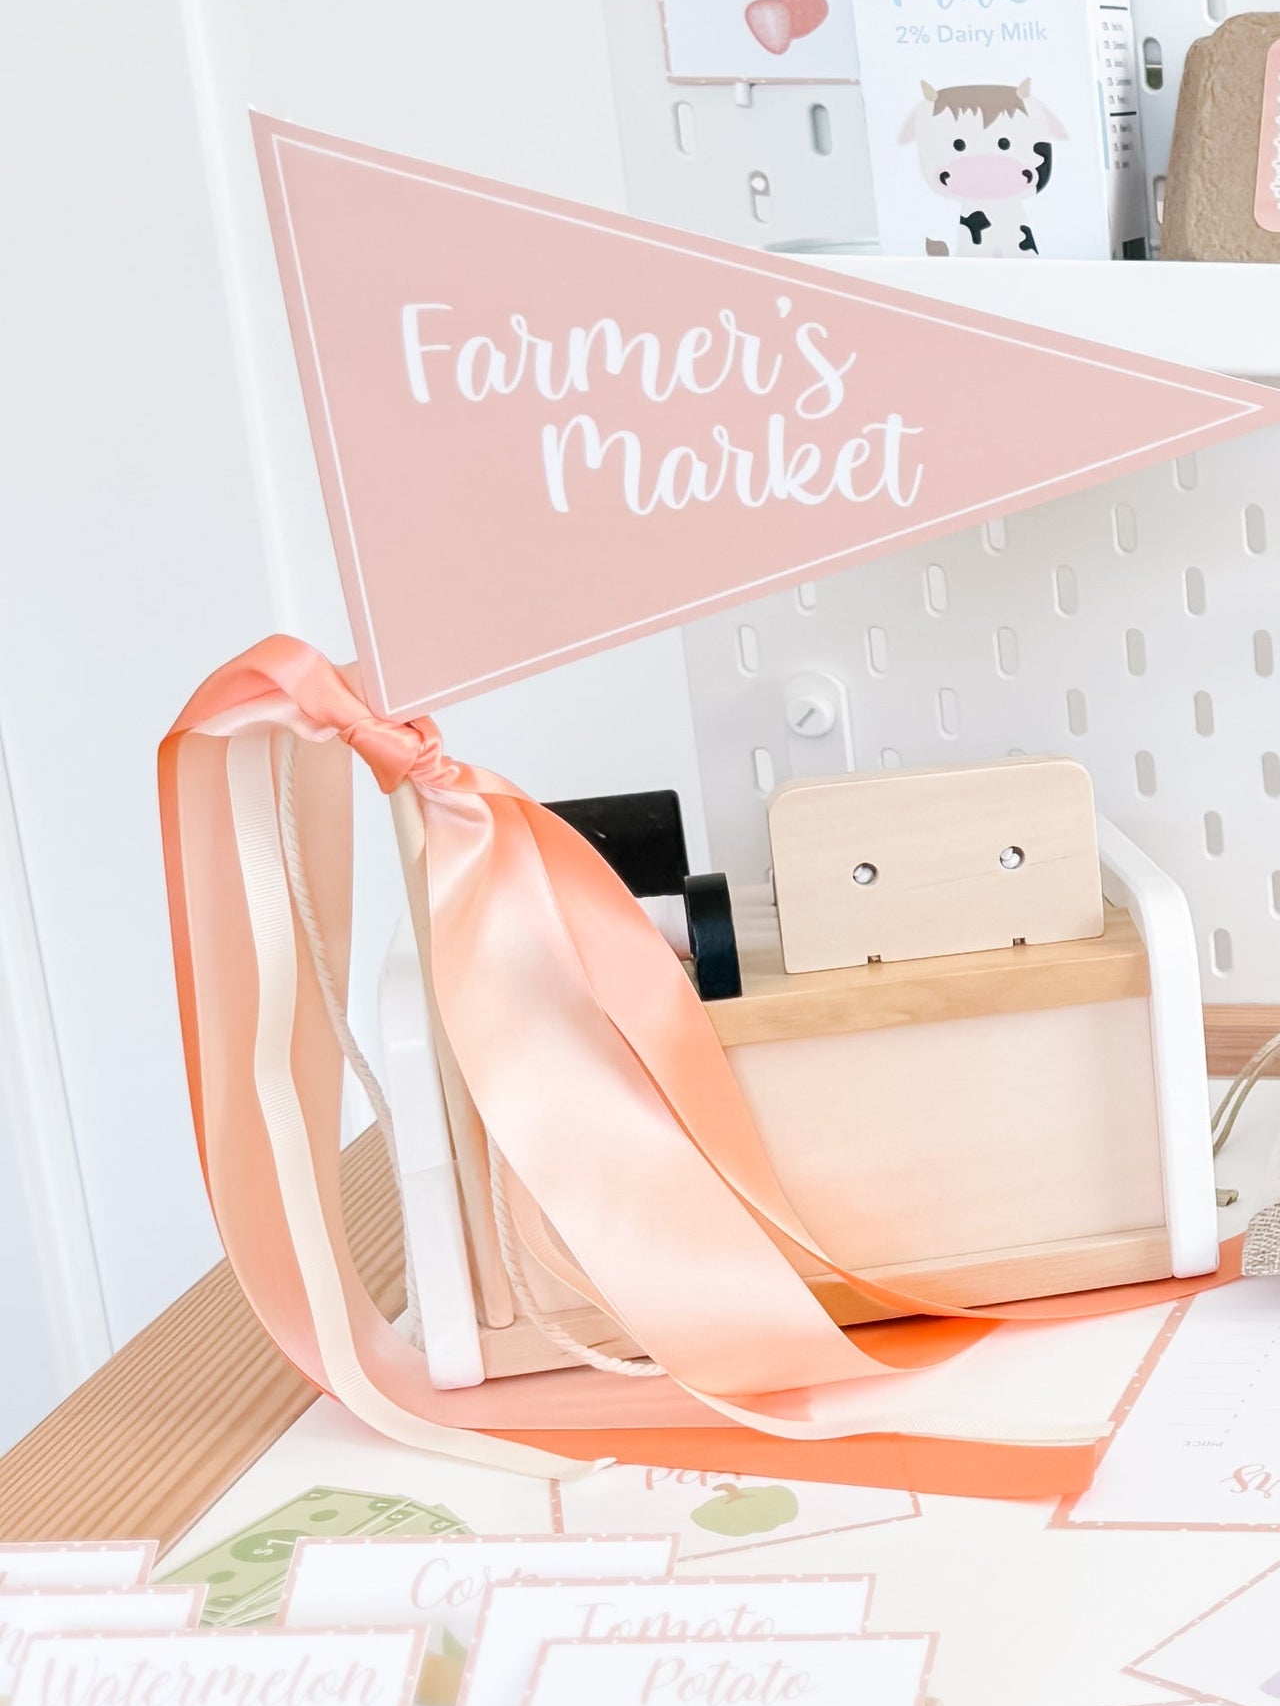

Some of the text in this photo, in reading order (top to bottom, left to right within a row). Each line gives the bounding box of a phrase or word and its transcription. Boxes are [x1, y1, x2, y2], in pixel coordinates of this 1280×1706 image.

[896, 20, 1048, 47] 2% Dairy Milk
[400, 296, 856, 419] Farmer's
[541, 413, 925, 517] Market
[575, 1601, 776, 1638] Tomato
[641, 1656, 819, 1706] Potato
